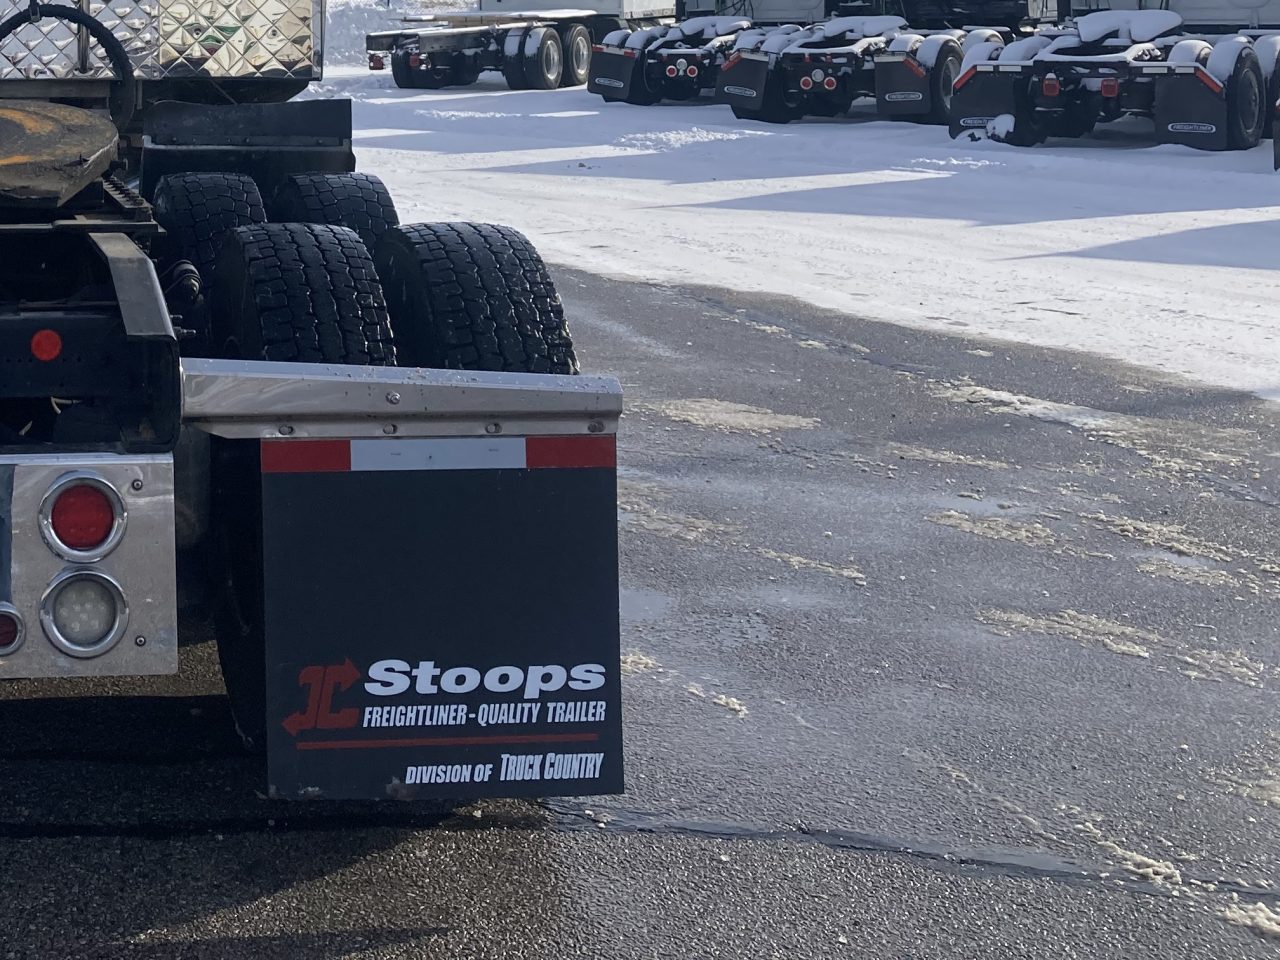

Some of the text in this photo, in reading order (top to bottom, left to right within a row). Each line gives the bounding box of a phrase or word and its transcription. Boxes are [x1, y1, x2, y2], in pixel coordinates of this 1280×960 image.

[364, 659, 606, 699] Stoops
[546, 700, 607, 723] TRAILER
[405, 764, 471, 785] DIVISION
[473, 763, 494, 782] OF
